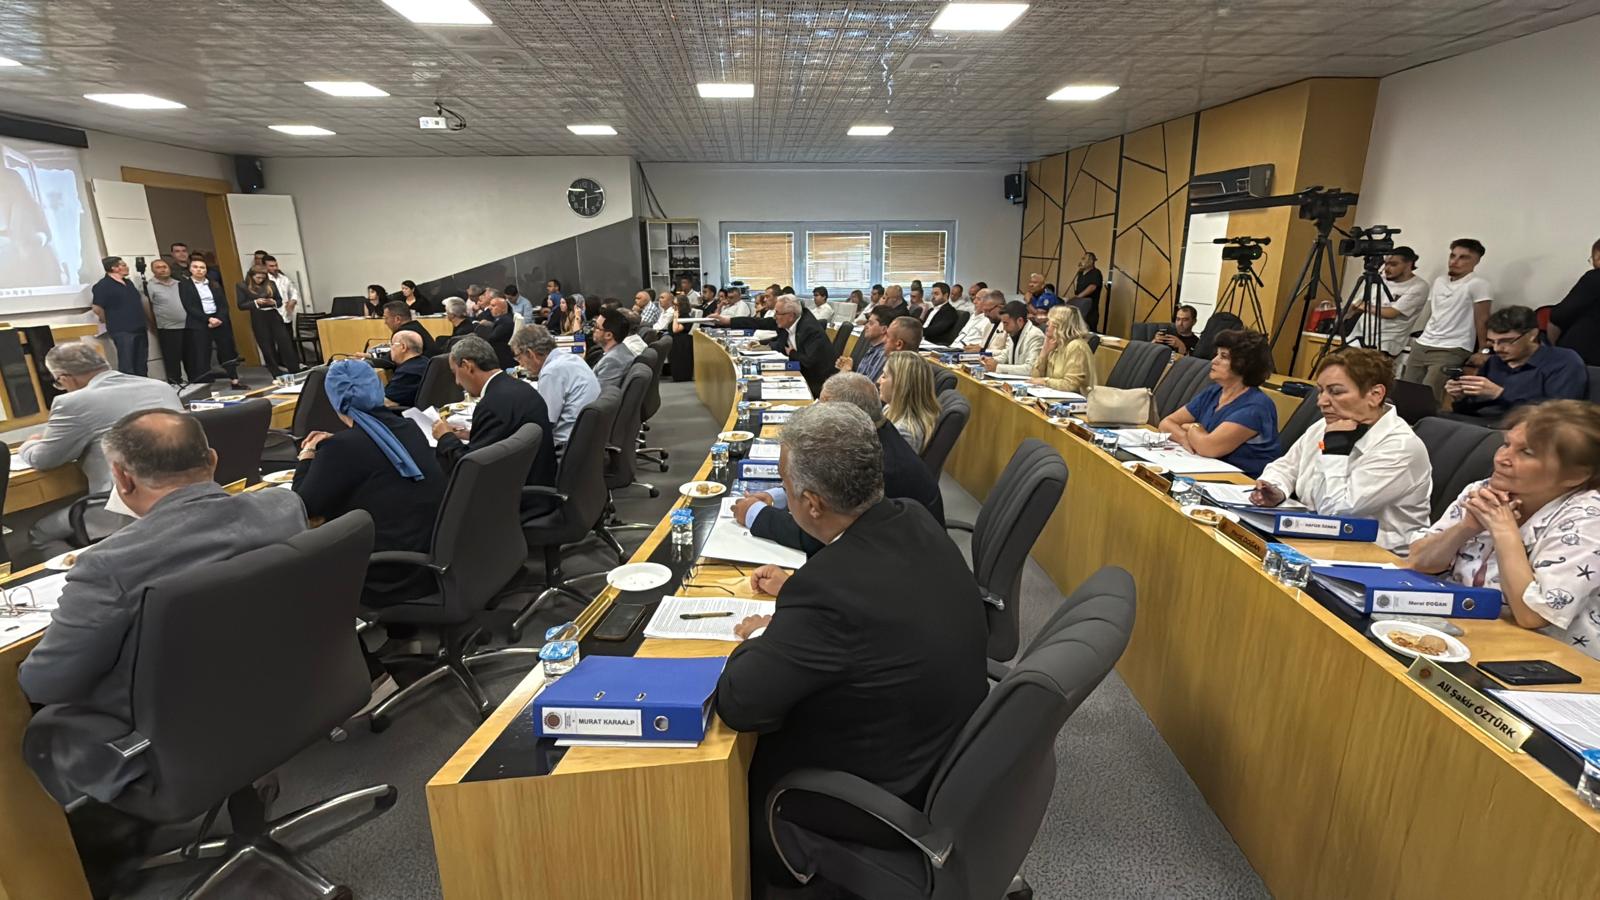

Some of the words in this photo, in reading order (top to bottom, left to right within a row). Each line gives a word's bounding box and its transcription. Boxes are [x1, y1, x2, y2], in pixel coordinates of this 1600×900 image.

[1437, 681, 1450, 693] Ali
[1450, 692, 1474, 709] Şakir
[1474, 705, 1516, 738] ÖZTÜRK
